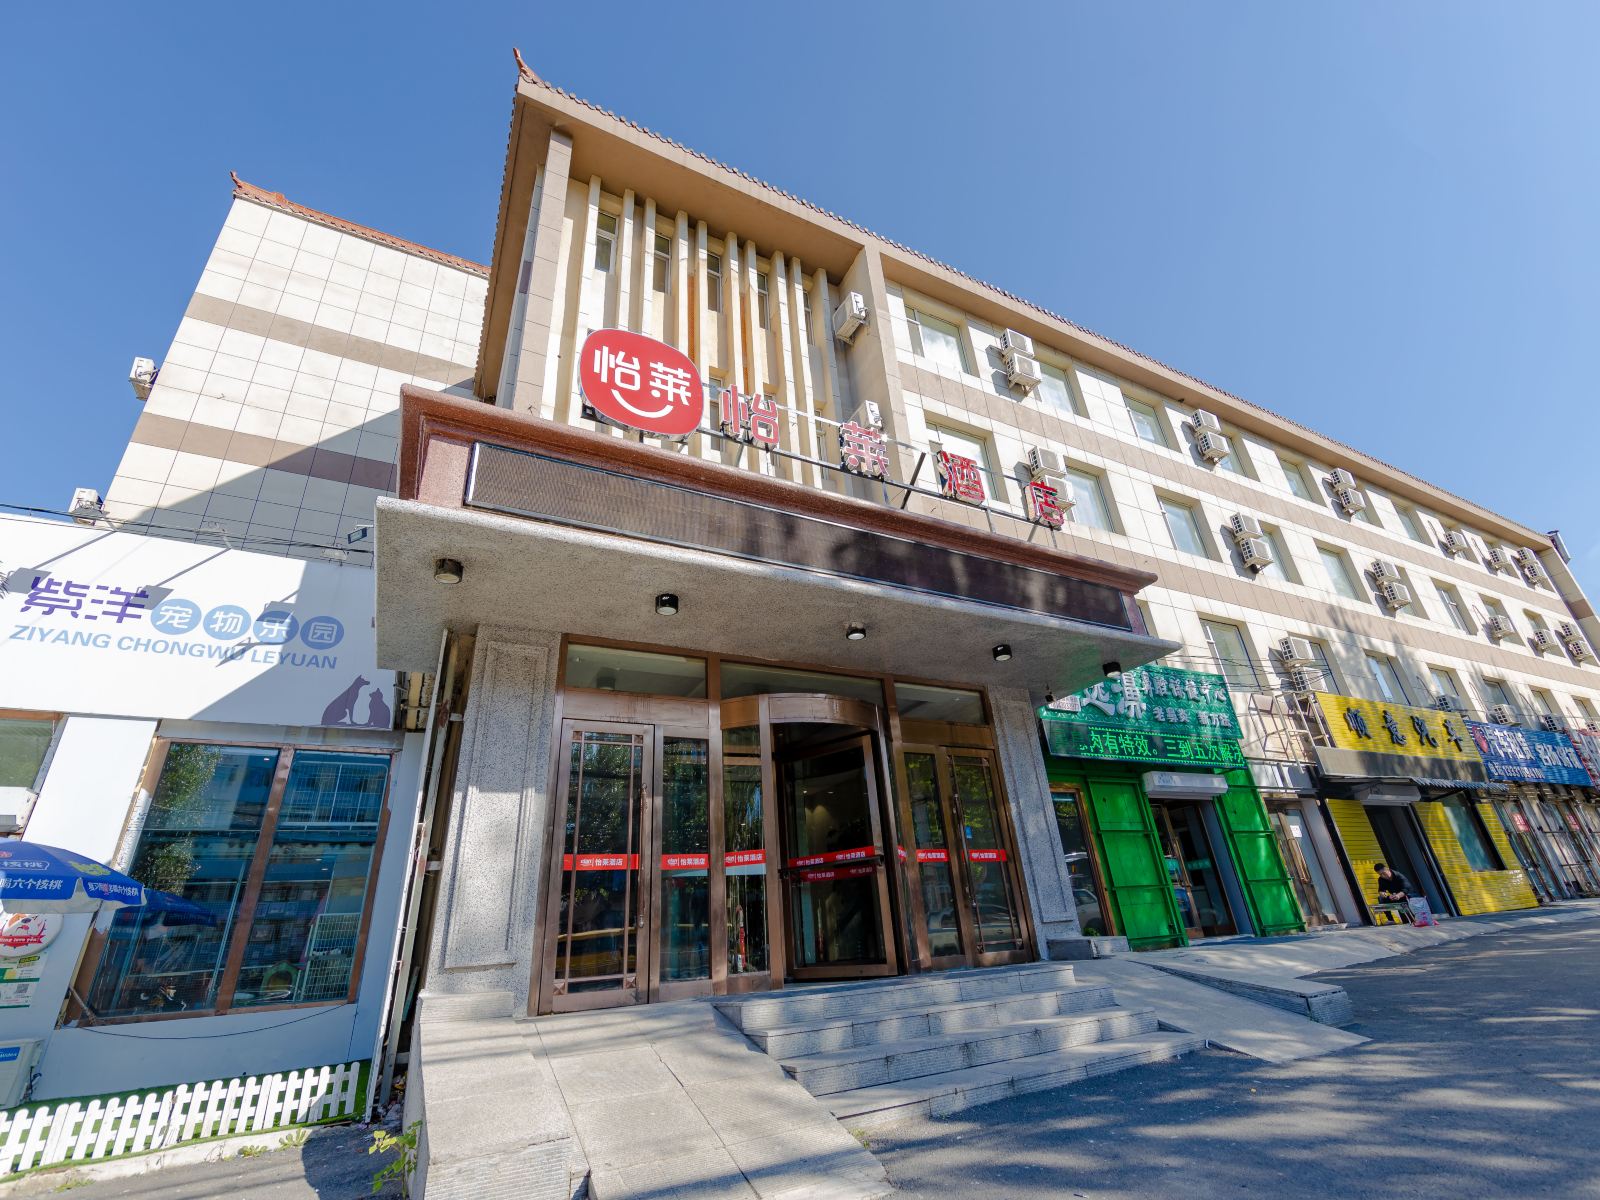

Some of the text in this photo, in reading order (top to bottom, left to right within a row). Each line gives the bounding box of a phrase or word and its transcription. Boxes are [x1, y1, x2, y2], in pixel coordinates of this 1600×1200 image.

[593, 345, 692, 406] 怡莱
[722, 384, 1065, 531] 怡莱酒店
[19, 575, 341, 645] 紫洋 宠物乐园
[9, 624, 339, 670] ZIYANG CHONGWU LEYUAN
